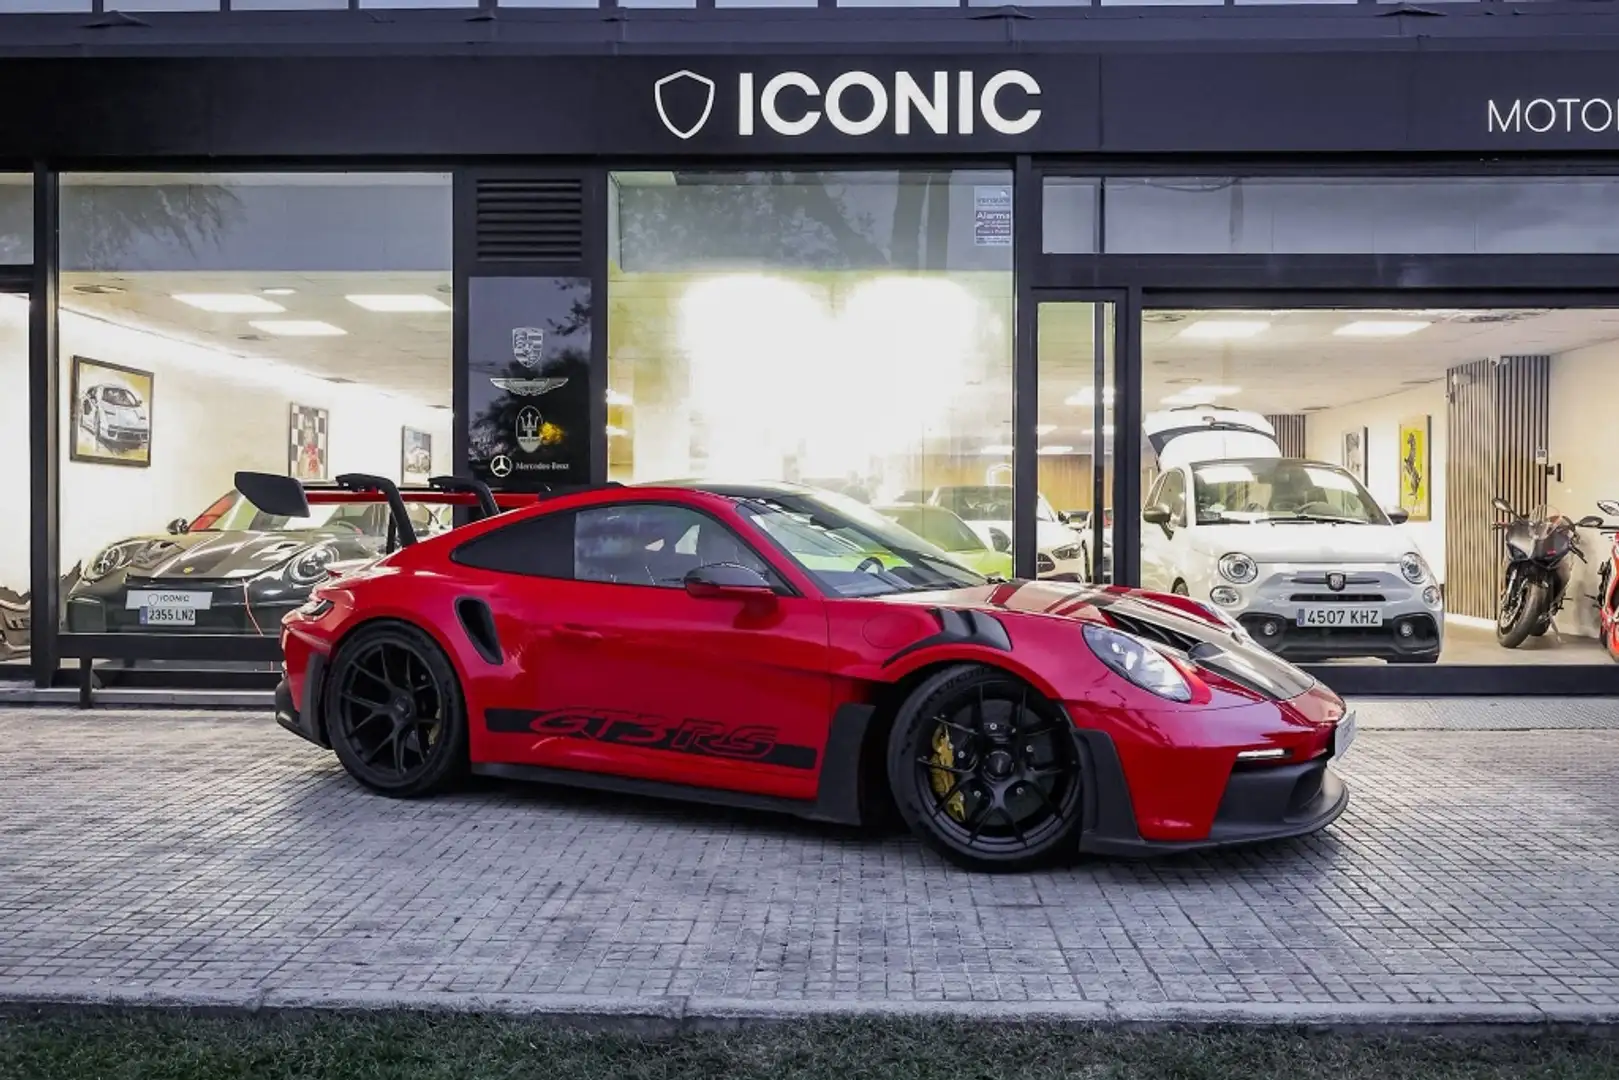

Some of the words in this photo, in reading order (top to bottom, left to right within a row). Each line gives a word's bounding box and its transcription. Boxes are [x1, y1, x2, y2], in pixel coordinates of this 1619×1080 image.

[739, 70, 1041, 136] ICONIC
[1488, 98, 1619, 133] MOTO
[160, 594, 190, 602] ICONIC
[149, 608, 174, 621] 2355
[175, 608, 194, 621] LNZ
[1307, 610, 1345, 624] 4507
[1350, 610, 1379, 624] KHZ
